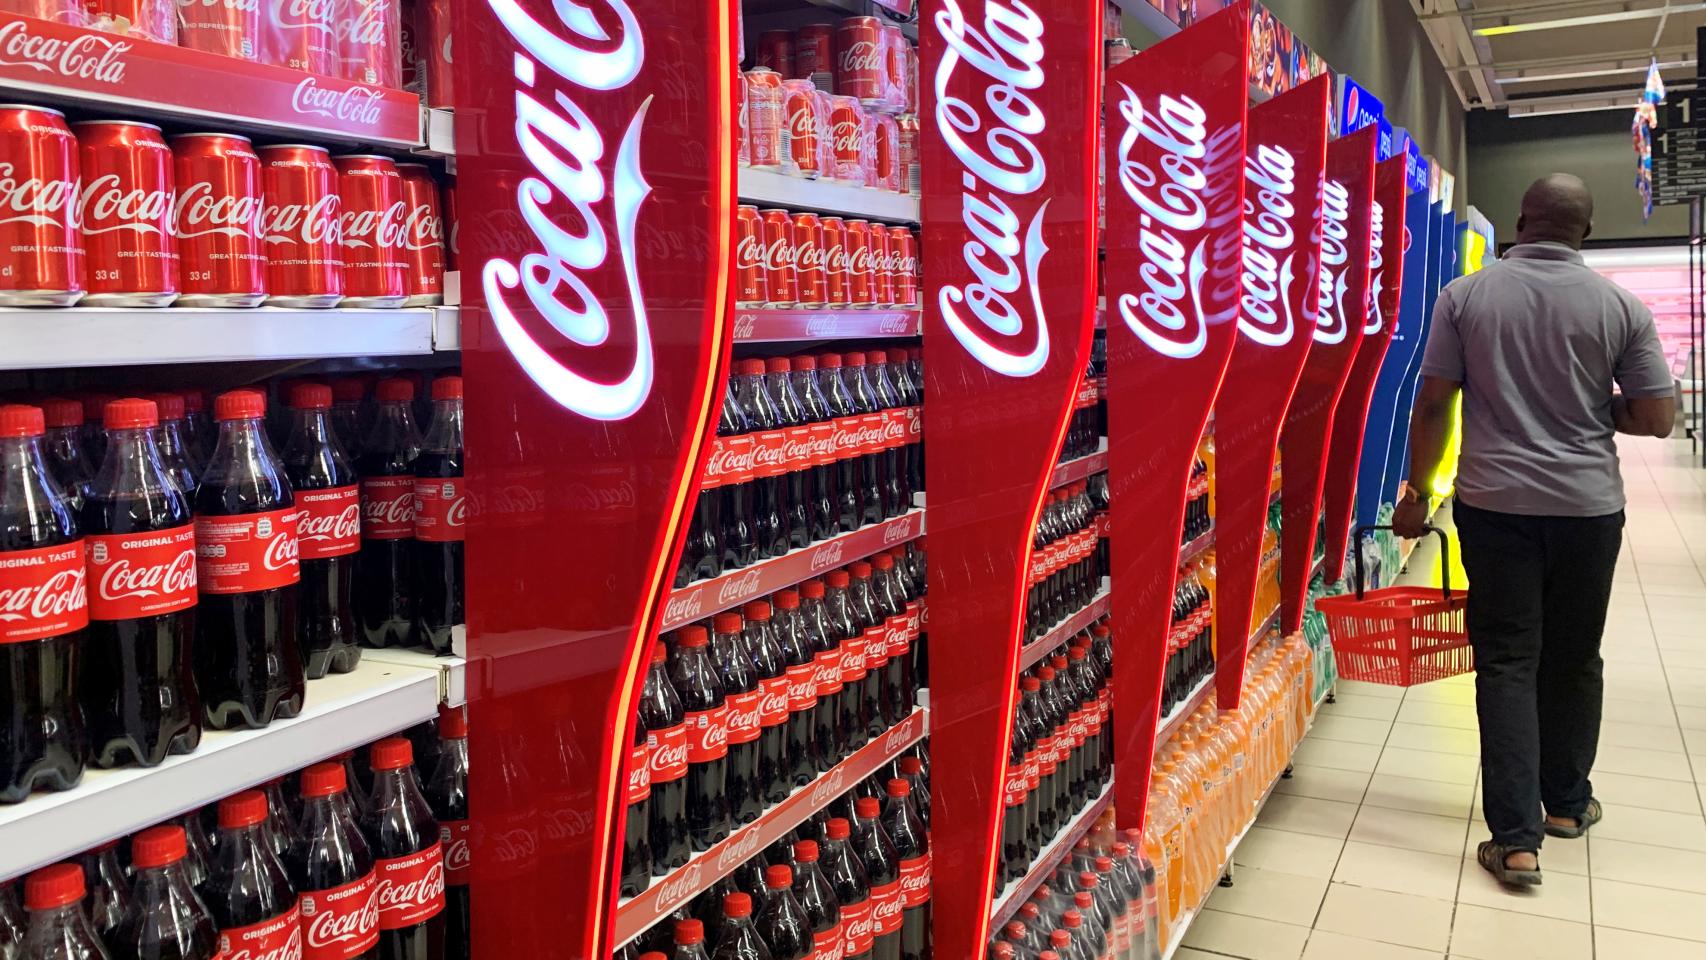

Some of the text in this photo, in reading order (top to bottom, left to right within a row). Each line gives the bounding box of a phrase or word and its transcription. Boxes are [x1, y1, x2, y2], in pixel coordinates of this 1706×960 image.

[0, 20, 132, 84] Coca-Cola
[290, 59, 300, 68] 33
[292, 77, 385, 124] Coca-Cola
[1677, 98, 1690, 123] 1
[1657, 133, 1668, 154] 1
[935, 0, 1050, 376] Coca-Cola
[1119, 80, 1208, 359] Coca-Cola
[96, 269, 119, 280] 33 cl
[189, 270, 210, 280] 33 cl
[880, 314, 909, 333] Coca-Cola
[304, 493, 342, 502] ORIGINAL
[121, 537, 173, 549] ORIGINAL
[884, 522, 912, 544] Coca-Cola
[48, 551, 76, 563] TASTE
[811, 541, 844, 571] Coca-Cola
[719, 569, 763, 604] Coca-Cola
[885, 718, 912, 754] Coca-Cola
[812, 766, 844, 807] Coca-Cola
[718, 824, 762, 872] Coca-Cola
[386, 857, 424, 871] ORIGINAL
[327, 884, 365, 902] ORIGINAL
[656, 862, 702, 912] Coca-Cola
[243, 921, 286, 940] ORIGINAL
